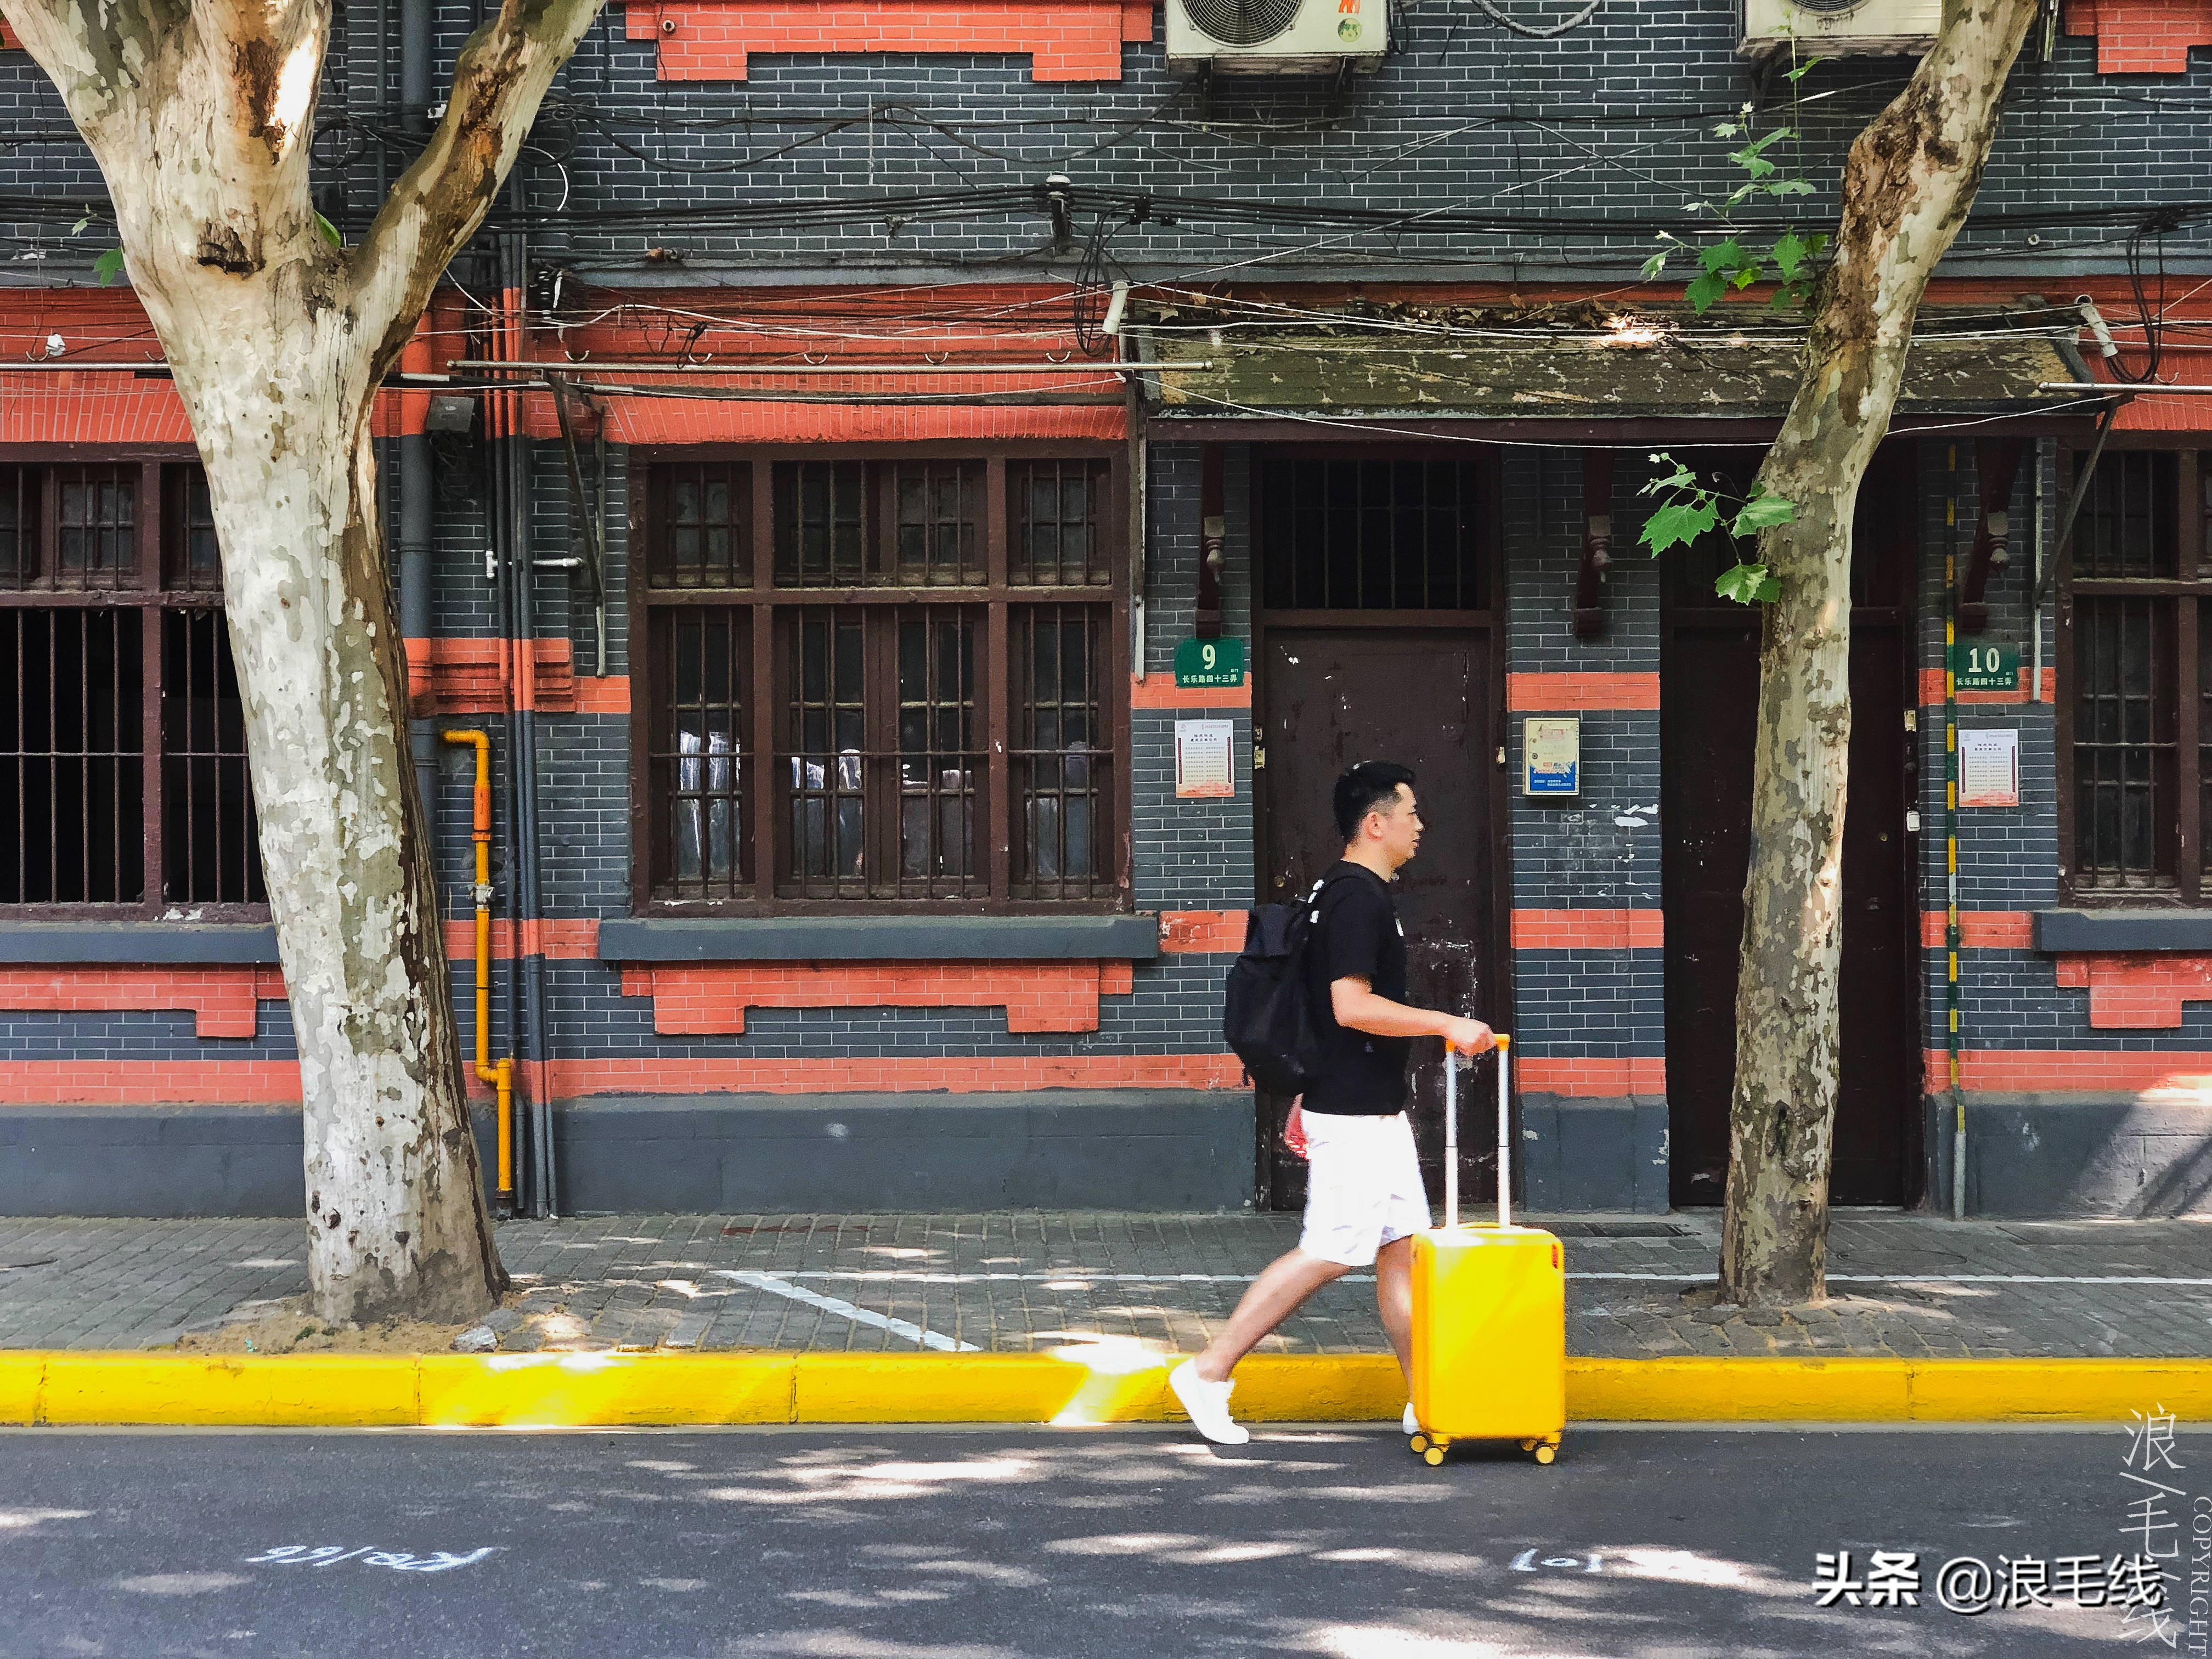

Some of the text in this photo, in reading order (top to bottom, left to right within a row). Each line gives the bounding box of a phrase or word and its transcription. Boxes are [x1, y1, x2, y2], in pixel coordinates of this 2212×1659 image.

[1202, 644, 1216, 670] 9
[1968, 647, 2000, 673] 10
[1182, 674, 1237, 683] 长乐路四十三弄
